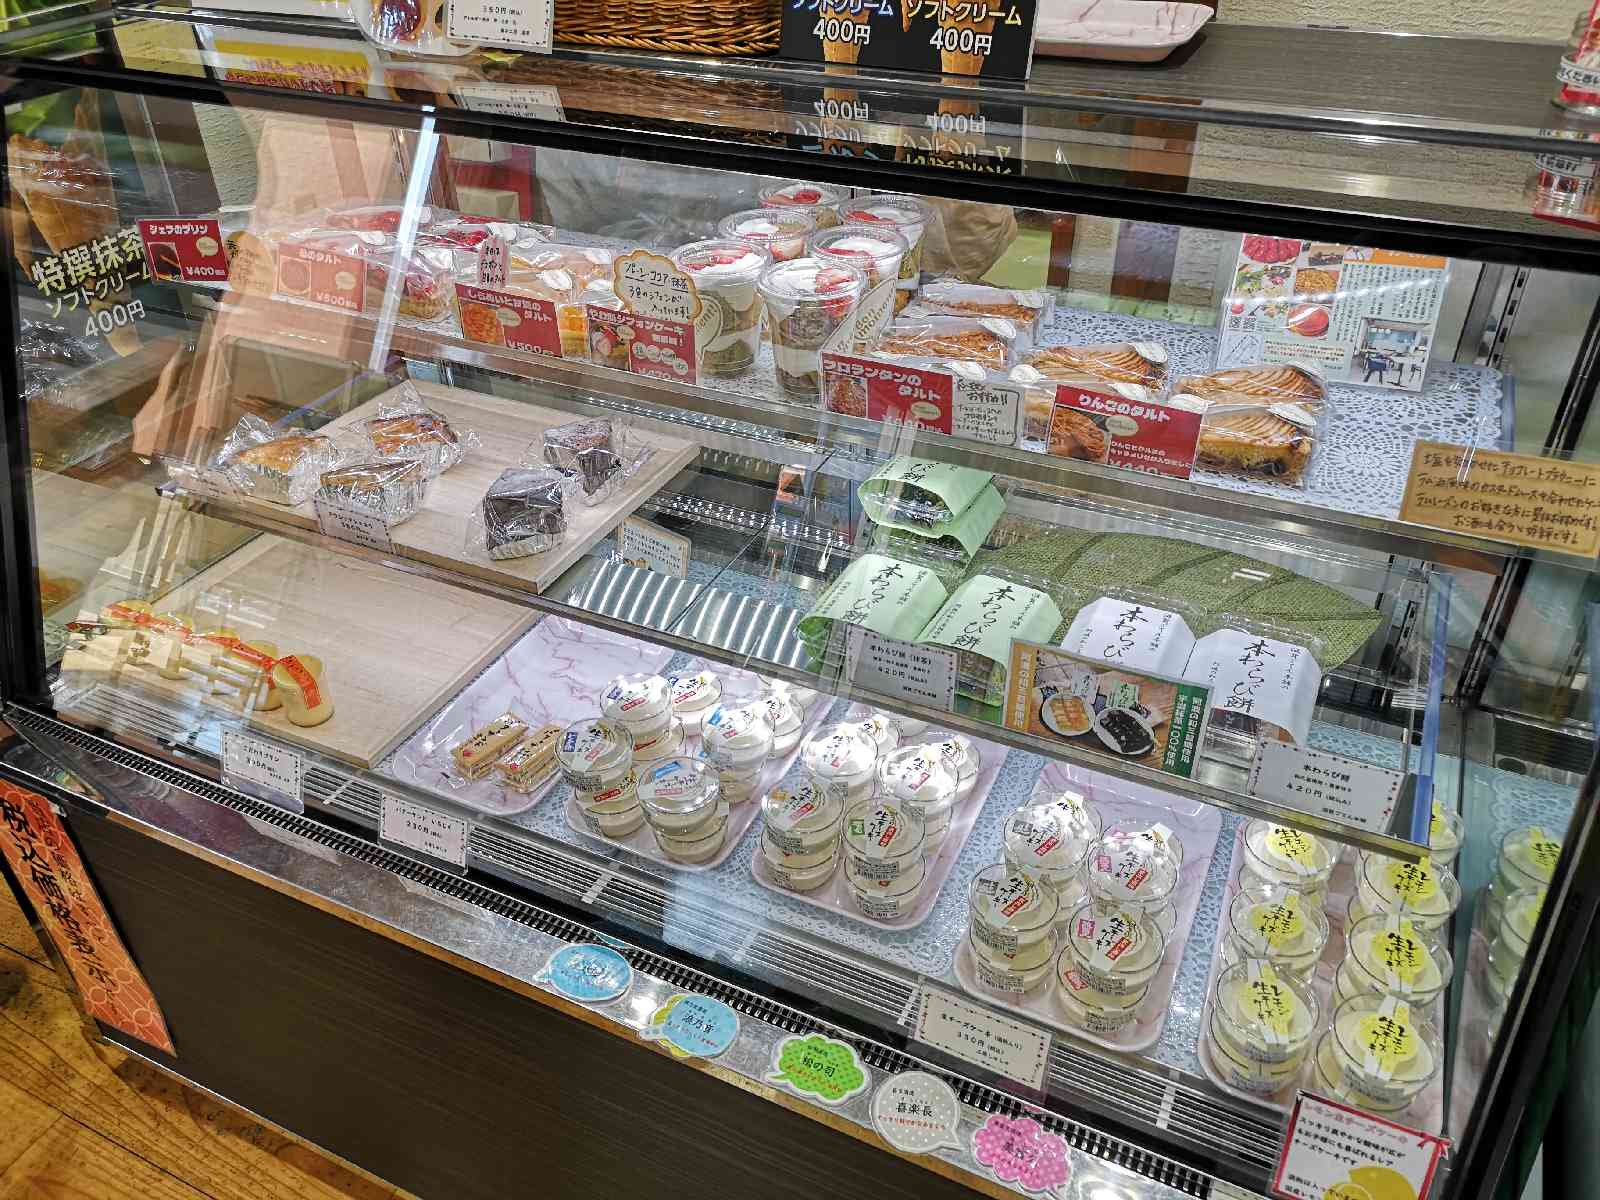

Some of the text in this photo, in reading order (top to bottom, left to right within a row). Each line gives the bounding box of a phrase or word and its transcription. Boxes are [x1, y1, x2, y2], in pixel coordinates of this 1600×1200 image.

[907, 1, 1022, 26] ソフトクリーム
[813, 19, 871, 45] 400円
[930, 28, 993, 56] 400円
[85, 299, 145, 337] 400円
[823, 359, 923, 386] フロランタンの
[898, 384, 941, 400] タルト
[1078, 393, 1170, 422] りんごのタルト
[840, 563, 904, 625] 本わらび餅
[951, 585, 1016, 650] 本わらび餅
[1103, 606, 1149, 660] 本わらび
[1223, 639, 1276, 713] 本わらび餅
[896, 1102, 933, 1117] 喜楽長
